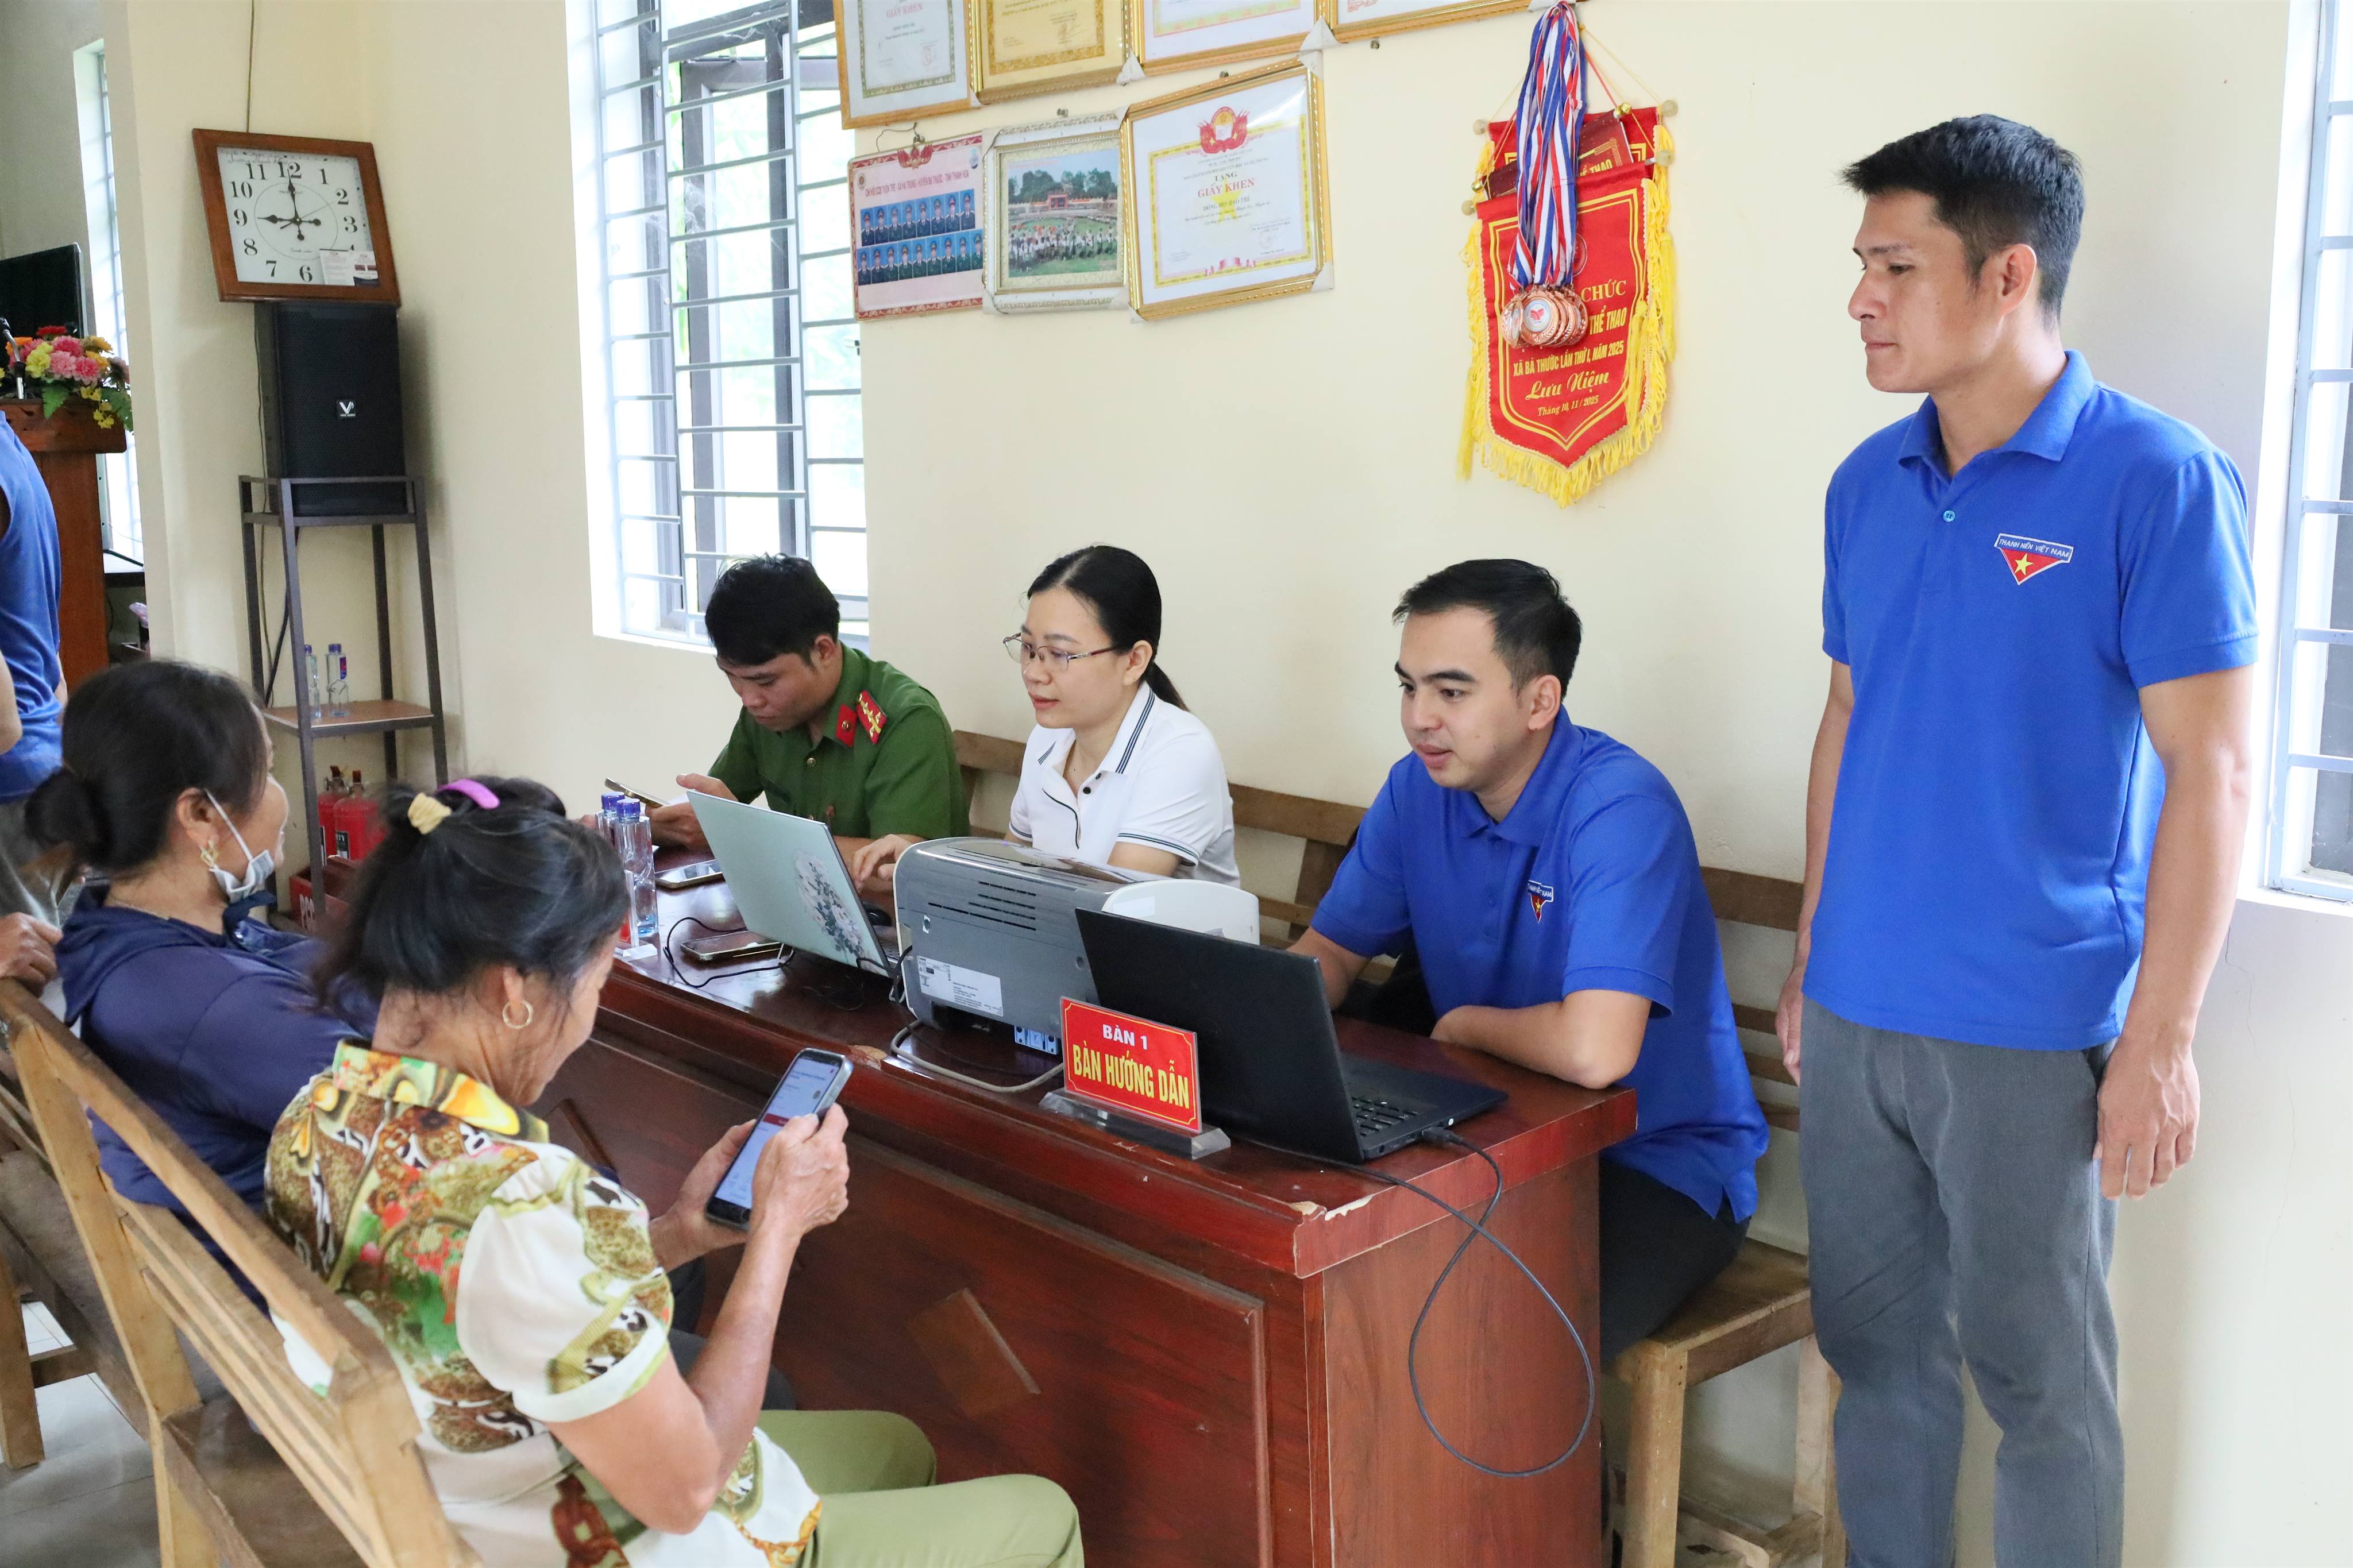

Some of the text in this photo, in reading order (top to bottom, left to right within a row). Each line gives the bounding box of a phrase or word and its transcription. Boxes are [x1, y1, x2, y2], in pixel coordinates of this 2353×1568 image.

[246, 163, 267, 180] 11
[279, 161, 302, 179] 12
[320, 168, 329, 184] 1
[230, 181, 252, 198] 10
[335, 188, 349, 205] 2
[1198, 178, 1256, 198] GIẤY KHEN
[234, 209, 248, 226] 9
[344, 216, 358, 233] 3
[244, 238, 258, 256] 8
[266, 260, 277, 277] 7
[299, 265, 313, 282] 6
[1581, 279, 1626, 302] CHỨC
[1590, 305, 1627, 335] THỂ THAO
[1513, 360, 1524, 377] XÃ
[1536, 354, 1559, 373] THƯỚC
[1561, 349, 1573, 369] LẦN
[1574, 347, 1587, 365] THỨ
[1592, 343, 1608, 361] NĂM
[1608, 340, 1624, 357] 2025
[1525, 370, 1609, 401] Lưu Niệm
[1537, 405, 1560, 417] Tháng
[1561, 402, 1569, 412] 10,
[1999, 539, 2020, 548] THANH
[2035, 545, 2049, 553] VIỆT
[2050, 549, 2069, 558] NAM
[1102, 1024, 1148, 1050] BÀN 1
[1073, 1040, 1190, 1109] BÀN HƯỚNG DẪN
